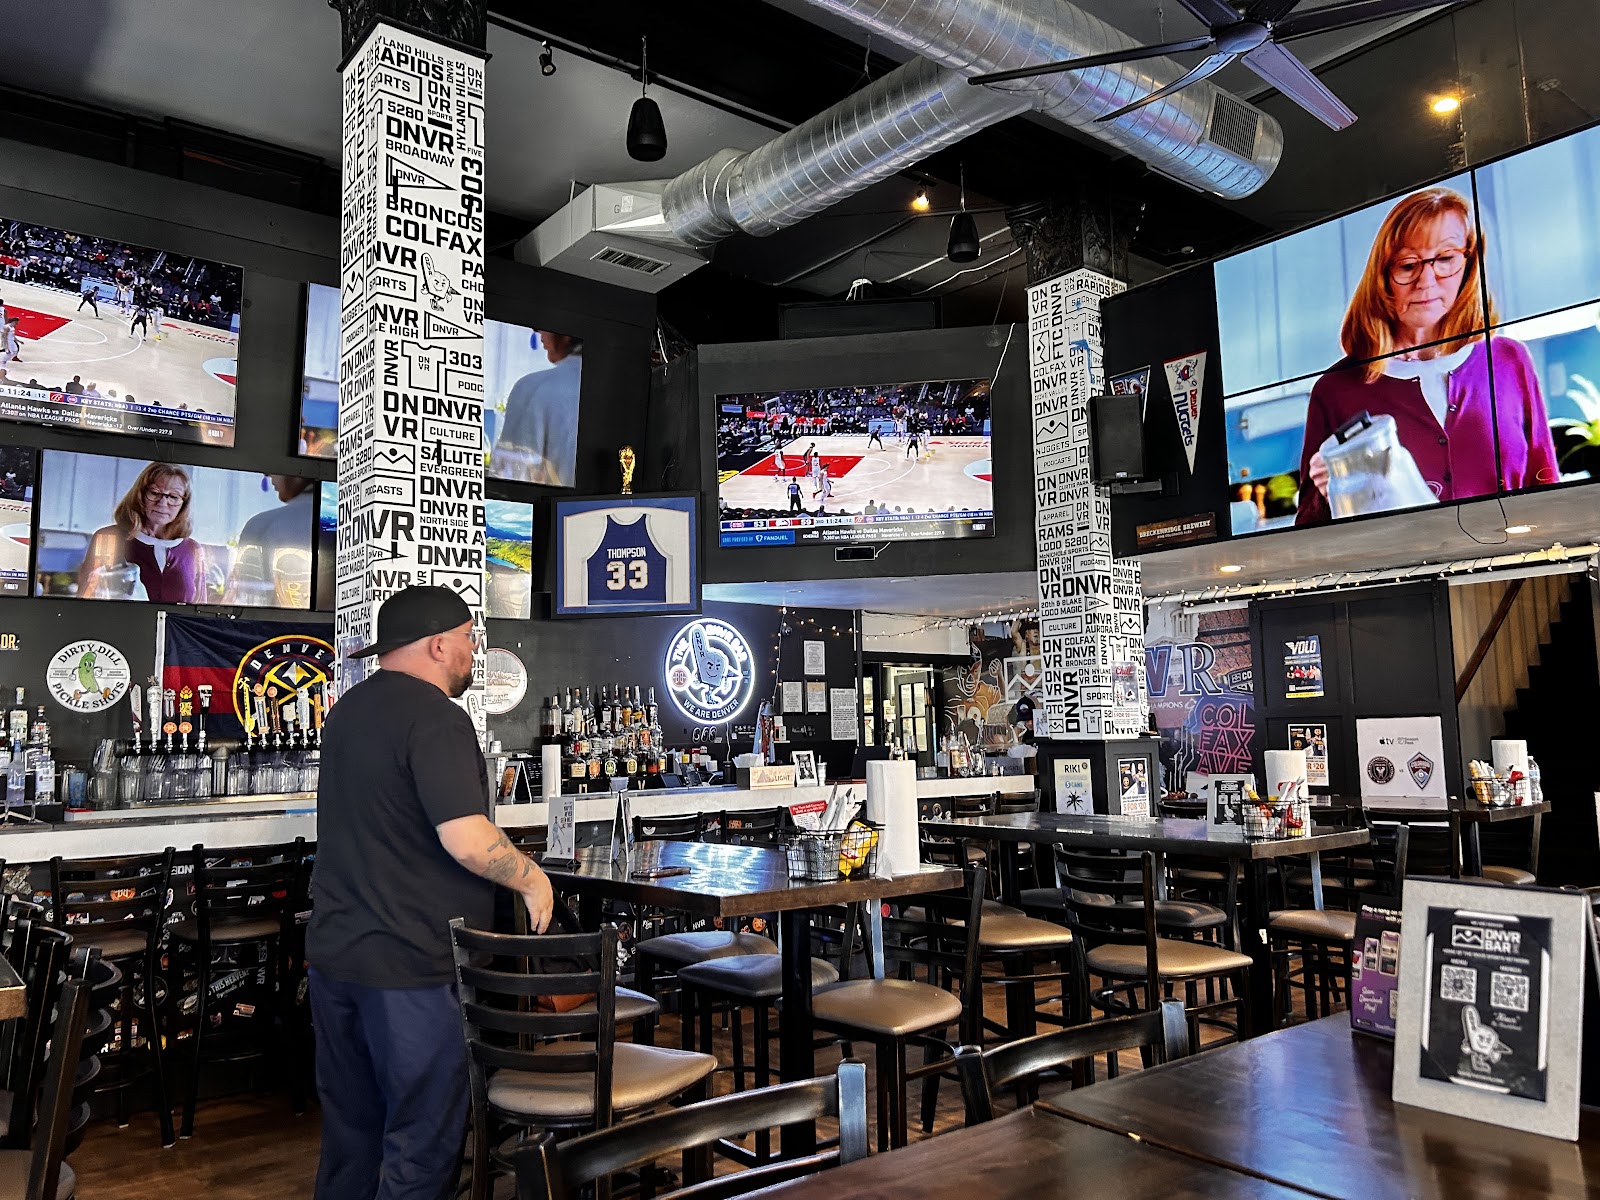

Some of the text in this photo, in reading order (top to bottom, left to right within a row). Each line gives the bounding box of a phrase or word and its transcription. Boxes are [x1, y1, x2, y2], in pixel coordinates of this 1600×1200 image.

[374, 46, 444, 81] RAPIDS
[415, 47, 444, 65] HILLS
[427, 79, 451, 99] DN
[387, 100, 424, 122] 5280
[428, 94, 451, 114] VR
[456, 61, 467, 151] HYLAND HILLS
[386, 115, 455, 155] DNVR
[386, 138, 455, 168] BROADWAY
[396, 168, 425, 186] DNVR
[386, 193, 483, 233] BRONCOS
[386, 214, 483, 259] COLFAX
[366, 241, 418, 271] DNVR
[1032, 287, 1048, 302] DN
[1077, 279, 1111, 297] RAPIDS
[1032, 300, 1048, 315] VR
[1051, 281, 1063, 328] DNVR
[369, 303, 419, 329] DNVR
[390, 322, 419, 339] HIGH
[433, 323, 459, 337] DNVR
[354, 338, 375, 370] DNVR
[449, 351, 483, 369] 303
[340, 355, 354, 385] DN
[384, 340, 399, 387] DNVR
[1034, 360, 1067, 379] COLFAX
[1034, 371, 1067, 393] DNVR
[7, 388, 32, 398] 11:24
[158, 408, 180, 417] CHANCE
[340, 380, 353, 407] VR
[0, 402, 26, 411] Atlanta
[27, 405, 51, 414] Hawks
[62, 409, 82, 418] Dallas
[83, 412, 118, 422] Mavericks
[383, 390, 418, 416] DN
[422, 395, 483, 423] DNVR
[1035, 396, 1068, 416] DNVR
[41, 414, 64, 422] LEAGUE
[383, 415, 418, 440] VR
[430, 426, 476, 441] CULTURE
[339, 428, 363, 459] RAMS
[1036, 440, 1070, 455] NUGGETS
[420, 463, 483, 479] EVERGREEN
[1058, 468, 1089, 485] DNVR
[420, 475, 483, 501] DNVR
[1037, 474, 1056, 492] DN
[1038, 491, 1057, 507] VR
[1060, 486, 1089, 503] DNVR
[420, 499, 469, 518] DNVR
[1043, 510, 1070, 522] APPAREL
[1095, 500, 1110, 516] DN
[352, 509, 415, 547] DNVR
[420, 516, 469, 528] NORTH SIDE
[1096, 515, 1110, 531] VR
[1139, 519, 1211, 539] BRECKENRIDGE BREWERY
[420, 526, 468, 544] DNVR
[822, 528, 840, 536] Atlanta
[1039, 523, 1074, 542] RAMS
[607, 546, 647, 559] THOMPSON
[1039, 535, 1088, 552] LODO 5280
[417, 544, 483, 569] DNVR
[606, 559, 648, 590] 33
[1040, 567, 1060, 584] DN
[1113, 567, 1133, 580] DNVR
[1041, 583, 1061, 600] VR
[1063, 574, 1112, 598] DNVR
[1113, 585, 1134, 596] DNVR
[1062, 597, 1083, 606] BLAKE
[1113, 597, 1141, 612] DNVR
[1048, 622, 1077, 632] CULTURE
[1086, 612, 1112, 626] DNVR
[1086, 624, 1114, 634] AURORA
[695, 631, 705, 658] DNVR
[1043, 637, 1062, 654] DN
[1065, 634, 1096, 646] COLFAX
[1290, 639, 1318, 655] VOLO
[57, 643, 123, 667] DIRTY DILL
[1065, 646, 1096, 659] DNVR
[1100, 635, 1108, 665] DNVR
[1043, 654, 1063, 669] VR
[1045, 670, 1062, 683] DN
[52, 681, 90, 711] PICKLE
[91, 680, 125, 710] SHOTS
[1046, 683, 1062, 696] VR
[683, 698, 740, 719] WE ARE DENVER
[1063, 671, 1080, 734] DNVR
[1200, 702, 1256, 730] COL
[1199, 730, 1257, 764] FAX
[1064, 764, 1081, 774] RIKI
[1195, 754, 1253, 778] AVE
[775, 774, 790, 782] LIGHT
[1485, 929, 1521, 944] DNVR
[1485, 941, 1512, 955] BAR
